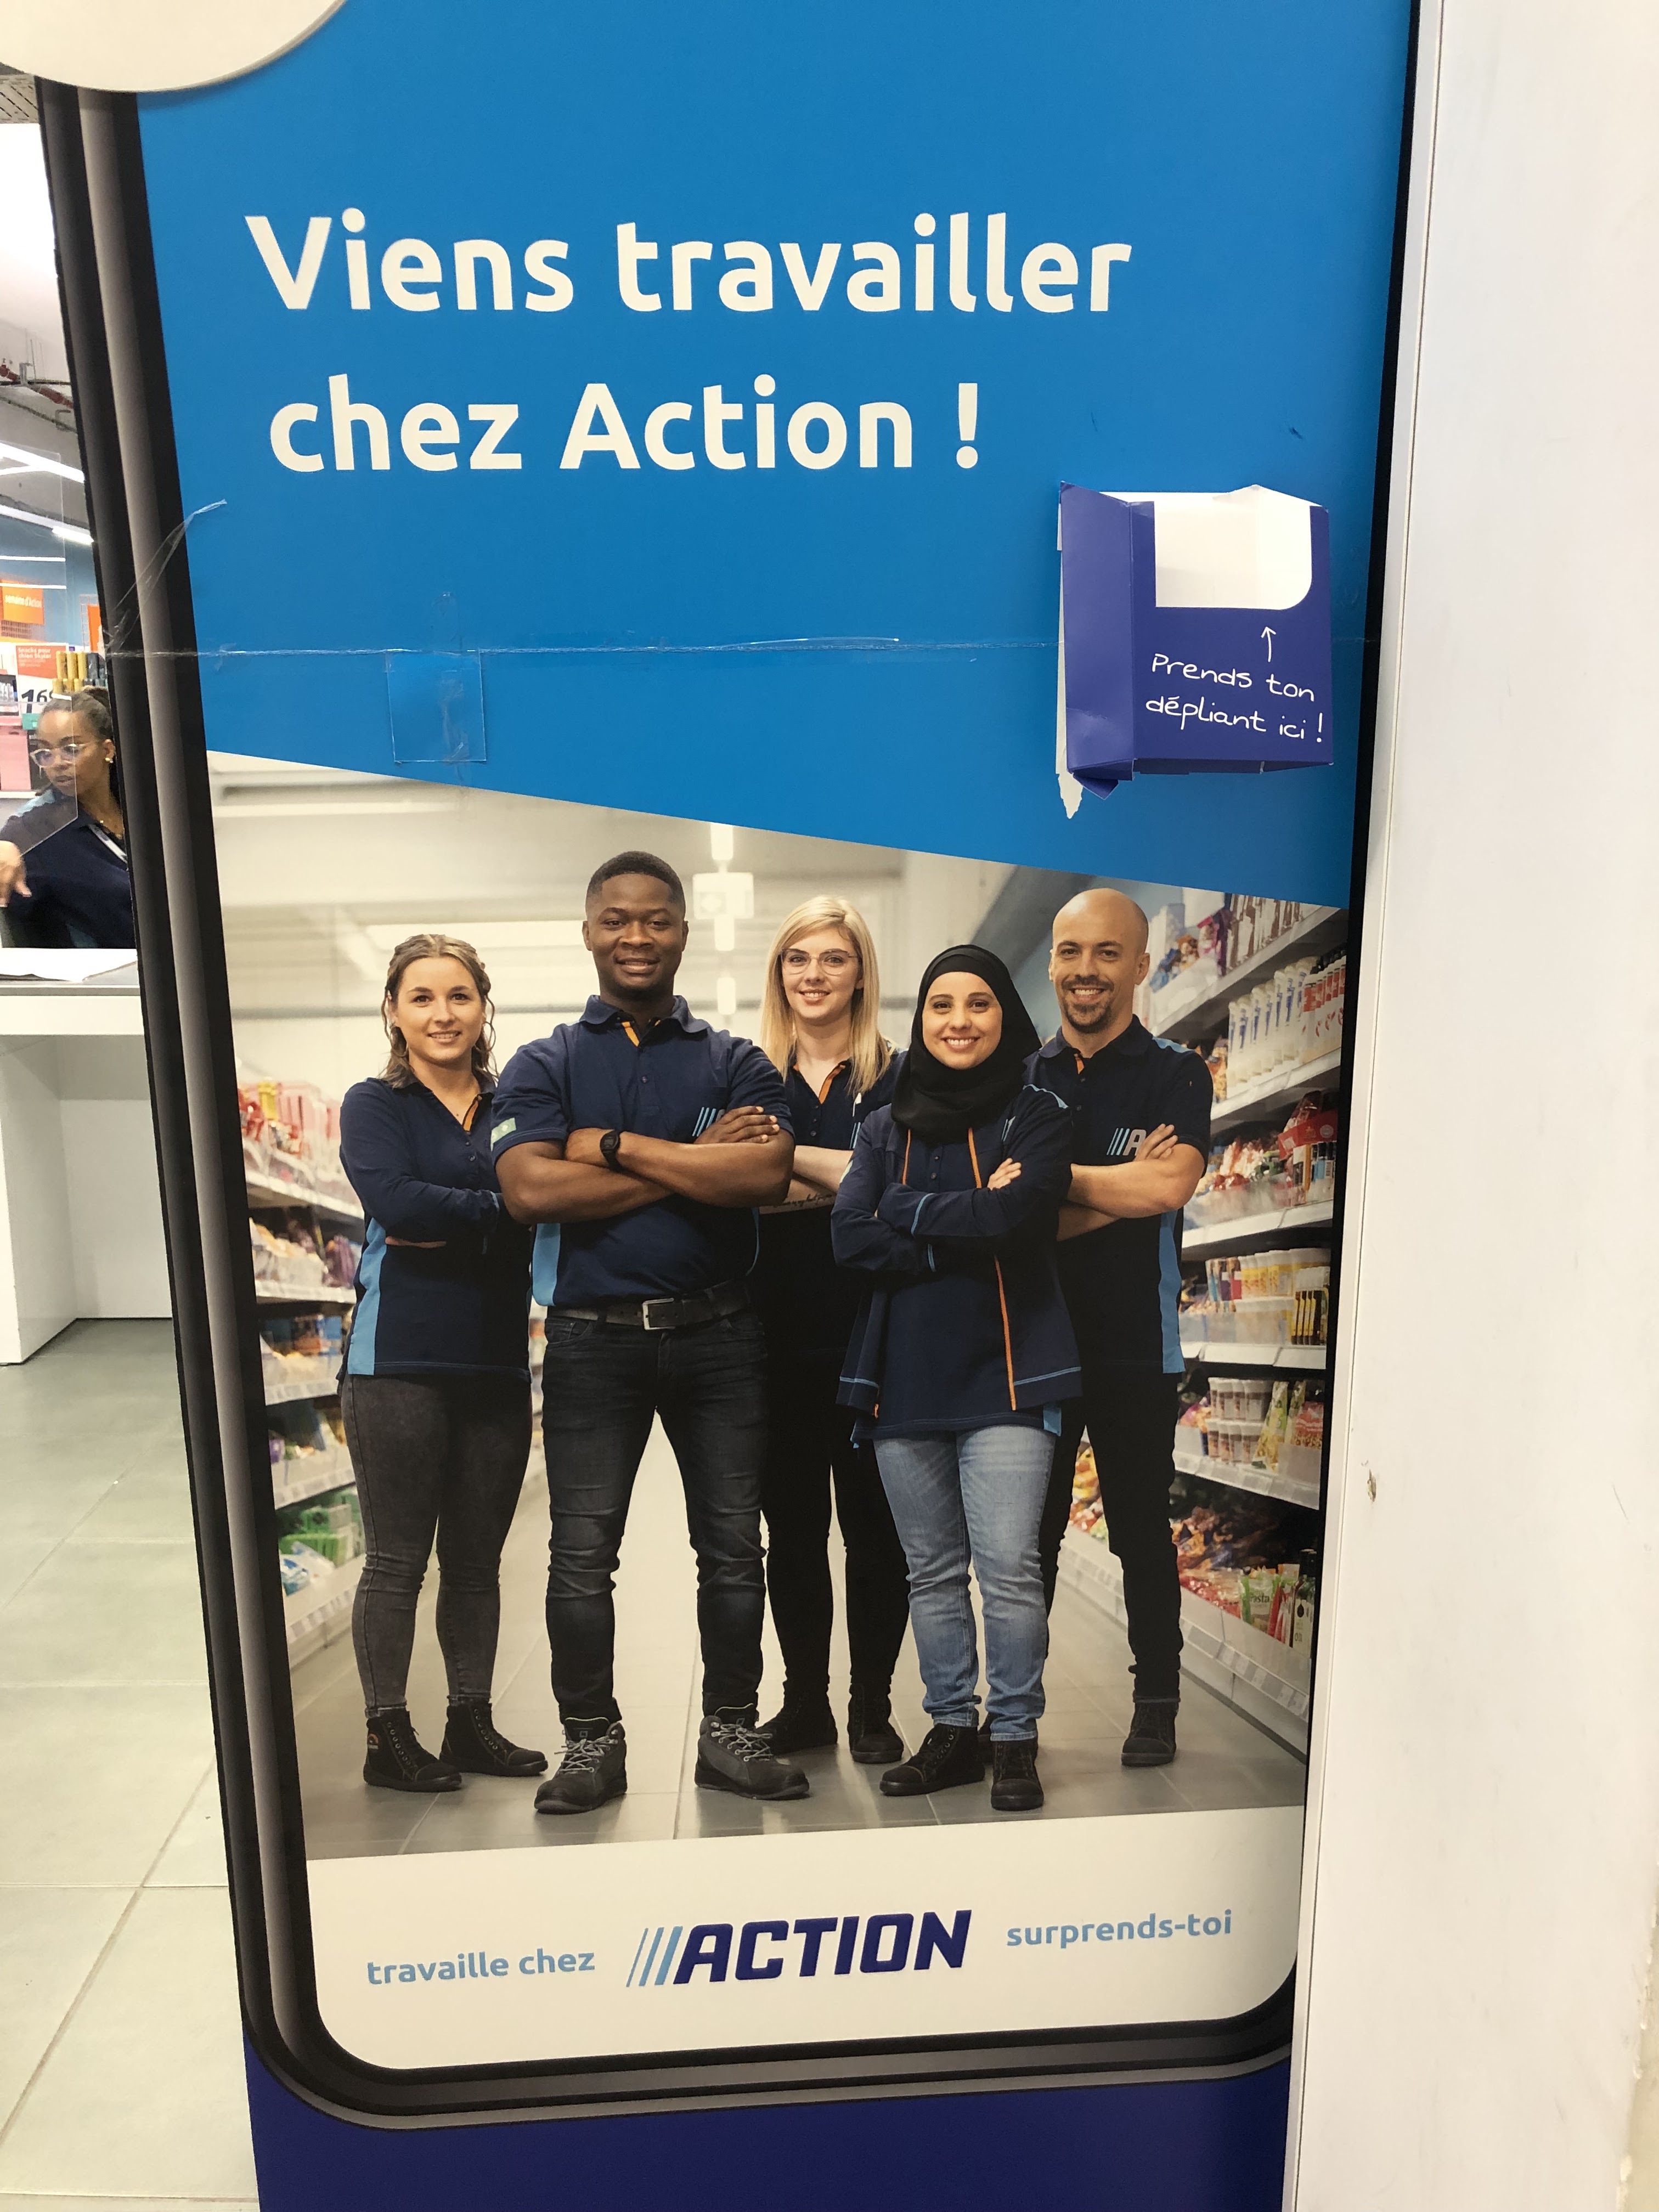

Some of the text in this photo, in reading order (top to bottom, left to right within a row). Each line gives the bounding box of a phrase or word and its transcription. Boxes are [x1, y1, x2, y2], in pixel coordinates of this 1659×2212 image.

[245, 207, 1132, 313] Viens travailler
[270, 373, 978, 472] chez Action !
[1152, 653, 1314, 702] Prends ton
[1146, 696, 1323, 743] dépliant ici !
[367, 1951, 509, 1985] travaille
[519, 1948, 595, 1975] chez
[1006, 1909, 1232, 1949] surprends-toi
